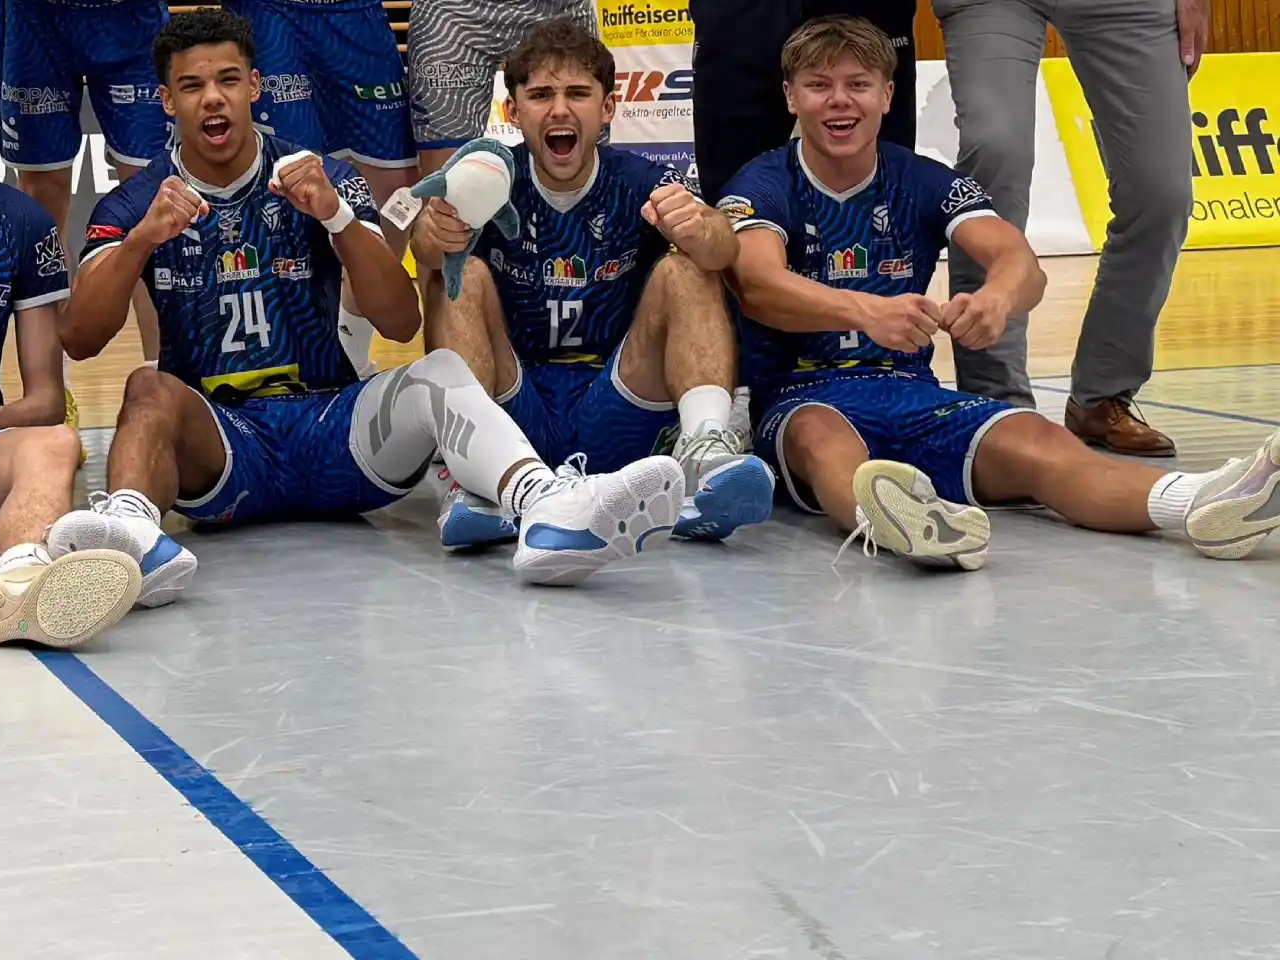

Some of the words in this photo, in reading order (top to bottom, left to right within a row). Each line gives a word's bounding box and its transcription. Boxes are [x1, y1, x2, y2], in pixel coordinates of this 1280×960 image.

[602, 4, 690, 28] Raiffeisen
[623, 106, 691, 119] elektro-regeltec
[1192, 191, 1280, 221] onaler
[219, 290, 271, 353] 24
[546, 299, 584, 349] 12
